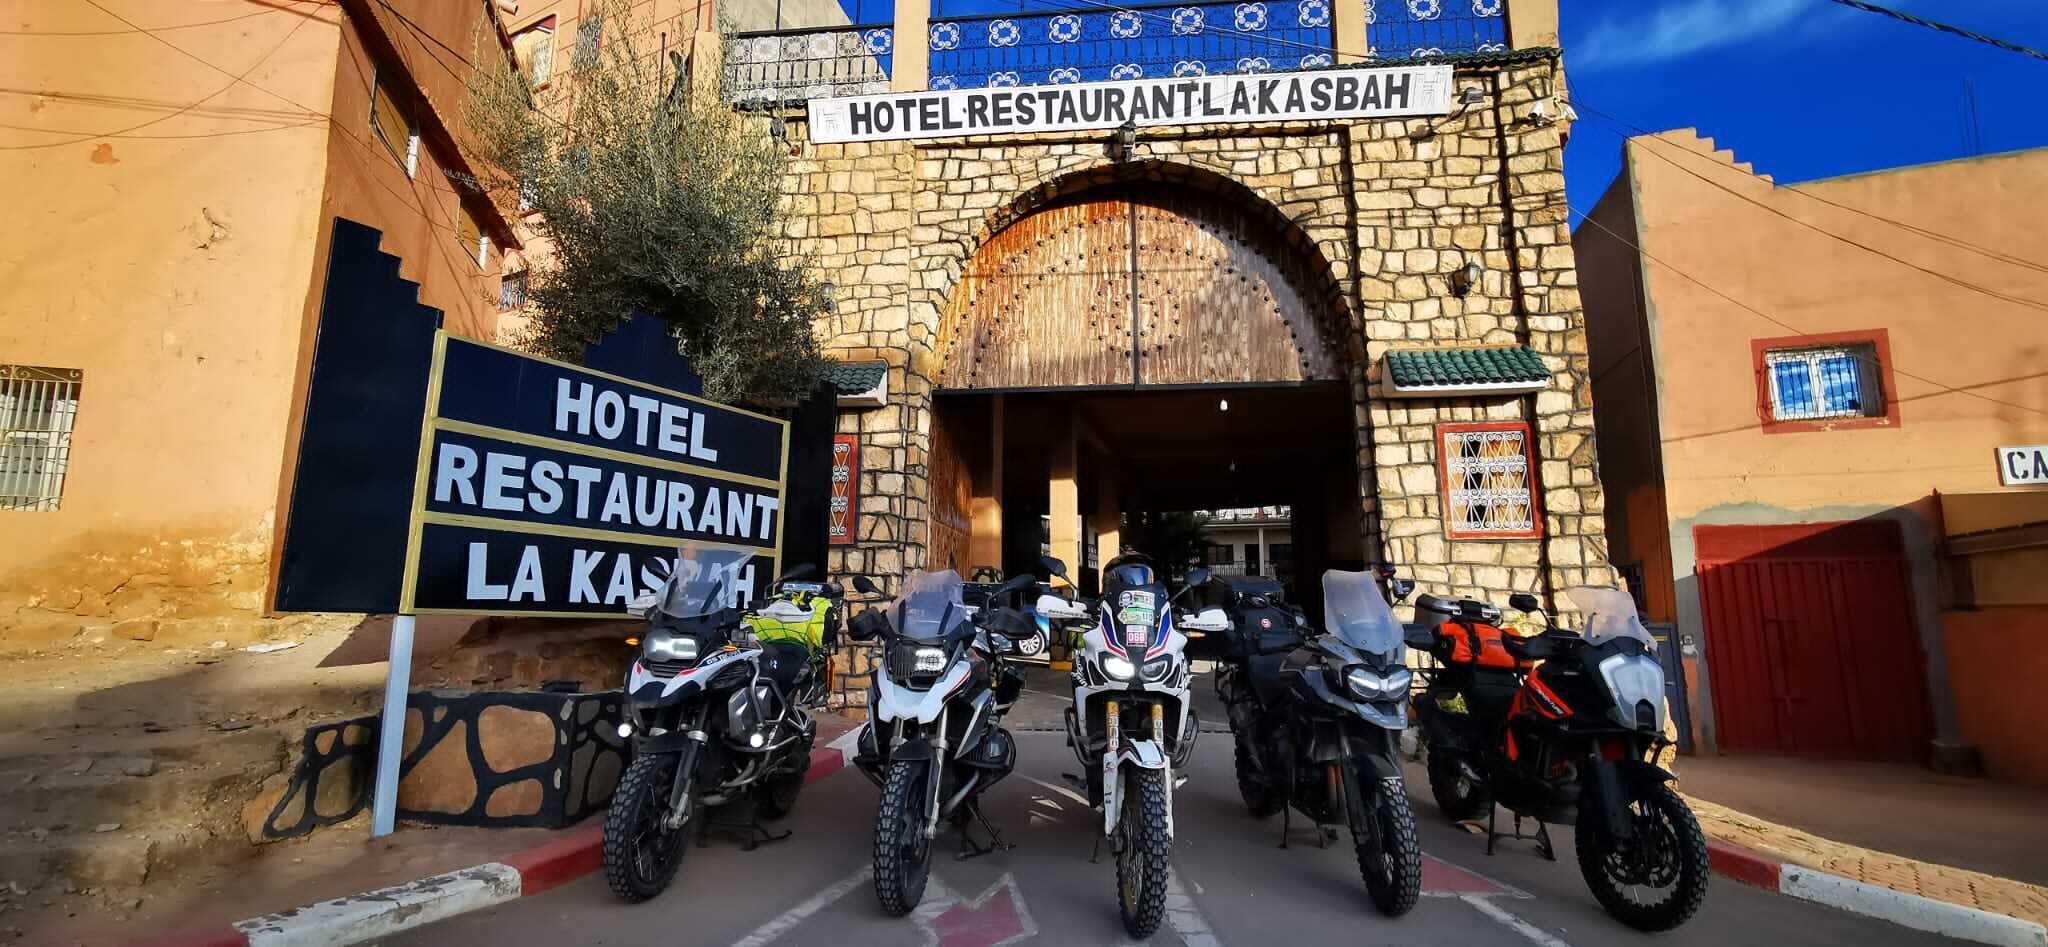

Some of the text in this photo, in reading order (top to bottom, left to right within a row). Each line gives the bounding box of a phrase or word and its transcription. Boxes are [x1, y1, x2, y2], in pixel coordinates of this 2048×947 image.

[850, 73, 1411, 135] HOTEL RESTAURANT LA KASBAH
[555, 377, 718, 463] HOTEL
[435, 443, 780, 540] RESTAURANT
[466, 542, 546, 603] LA
